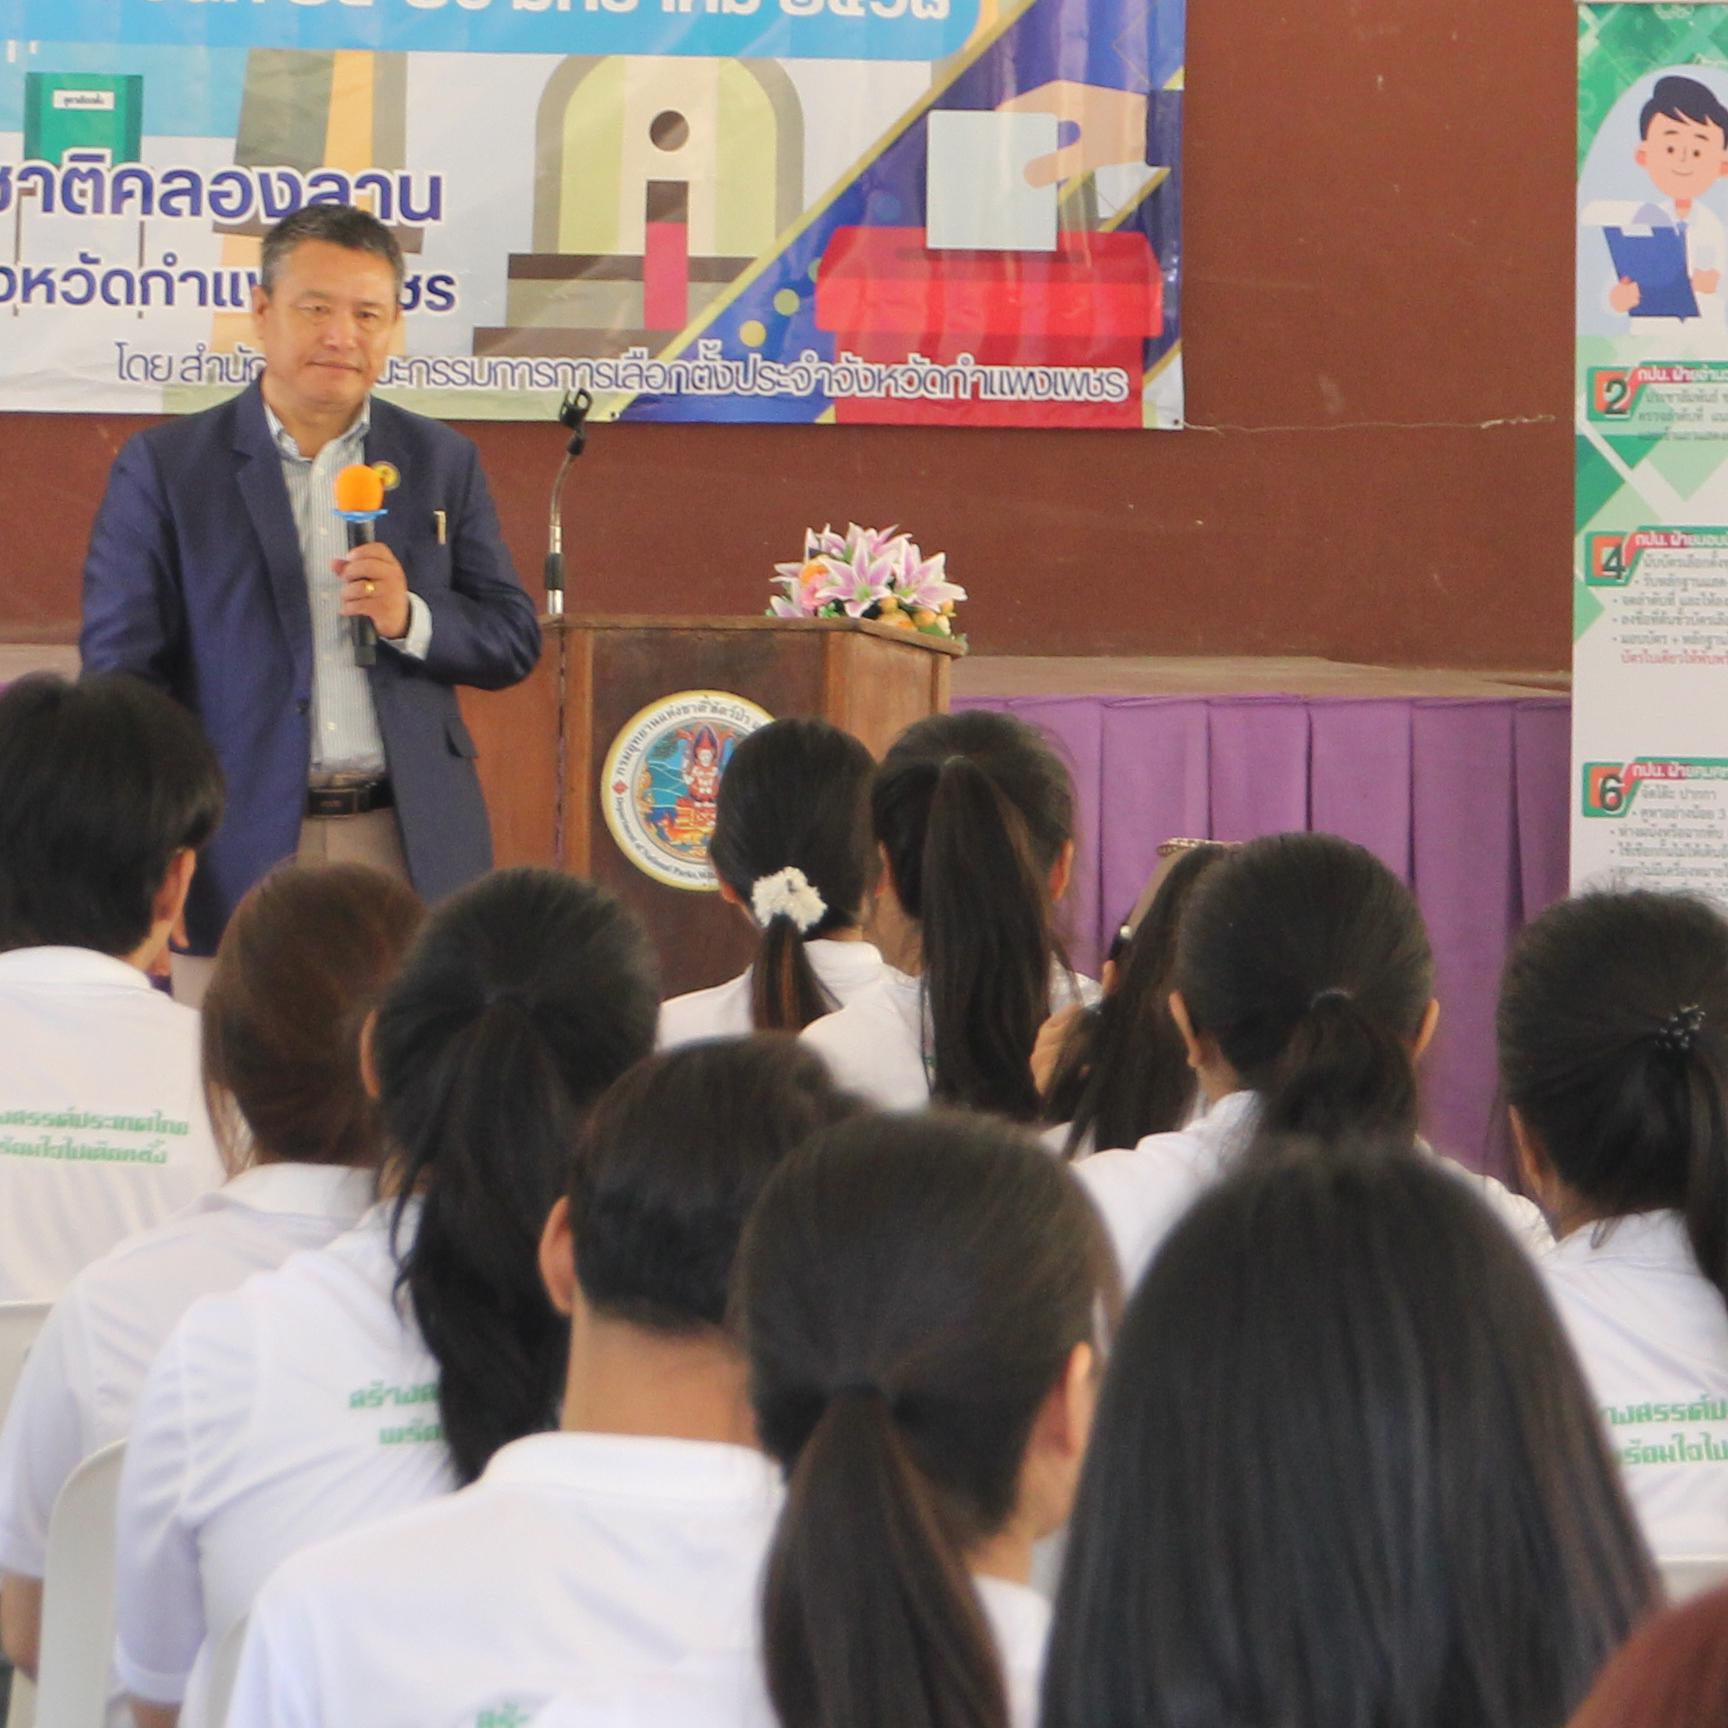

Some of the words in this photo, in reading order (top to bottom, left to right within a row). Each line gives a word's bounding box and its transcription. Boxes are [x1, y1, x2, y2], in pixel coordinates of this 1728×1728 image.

[115, 342, 173, 384] โดย
[180, 340, 1129, 402] สำนักะกรรมการการเลือกตั้งประจำจังหวัดกำแพงเพชร
[1603, 378, 1629, 415] 2
[1601, 544, 1626, 581] 4
[1599, 773, 1625, 812] 6
